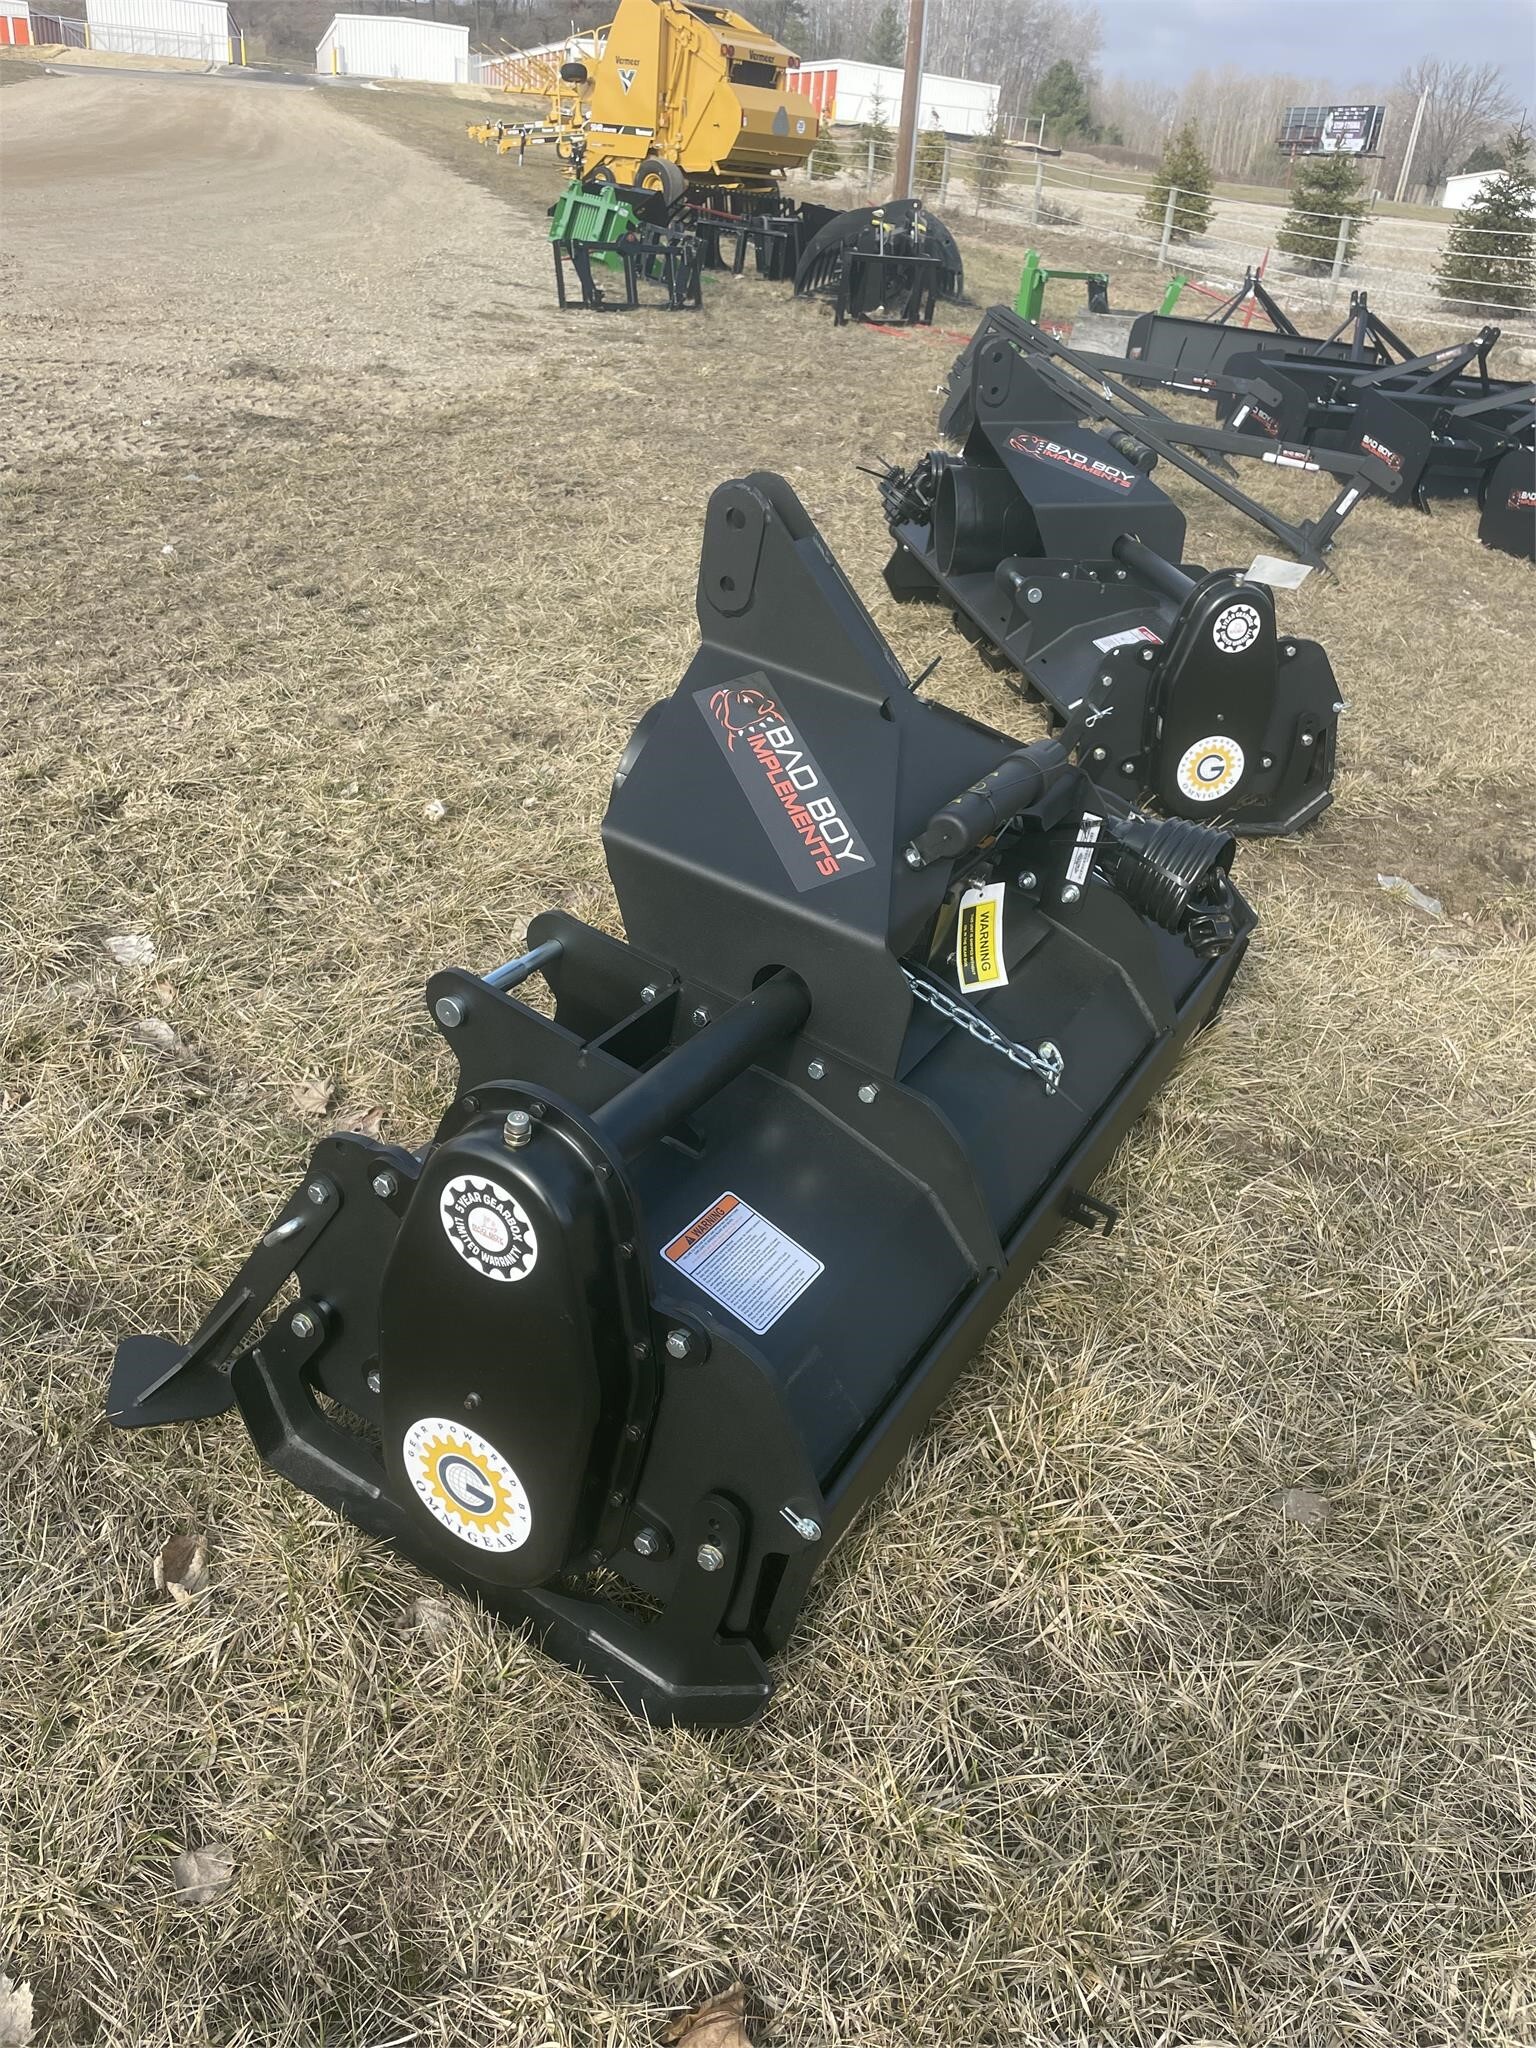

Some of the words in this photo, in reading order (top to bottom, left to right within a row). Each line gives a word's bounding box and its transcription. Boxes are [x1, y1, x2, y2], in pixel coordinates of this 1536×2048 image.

[615, 56, 640, 67] Vermeer
[749, 50, 776, 63] Vermeer
[1043, 449, 1132, 488] IMPLEMENTS
[1046, 442, 1087, 463] BAD
[1092, 460, 1136, 481] BOY
[746, 732, 840, 877] IMPLEMENTS
[765, 724, 819, 791] BAD
[806, 796, 866, 863] BOY
[1182, 777, 1236, 799] OMNIGEAR
[979, 910, 991, 972] WARNING
[454, 1216, 480, 1256] LIMITED
[481, 1244, 522, 1268] WARRANTY
[457, 1191, 482, 1209] YEAR
[482, 1193, 523, 1243] GEARBOX
[691, 1207, 726, 1237] WARNING
[408, 1425, 429, 1457] GEAR
[437, 1422, 517, 1488] POWERED
[438, 1455, 494, 1514] G
[415, 1479, 519, 1549] OMNIGEAR
